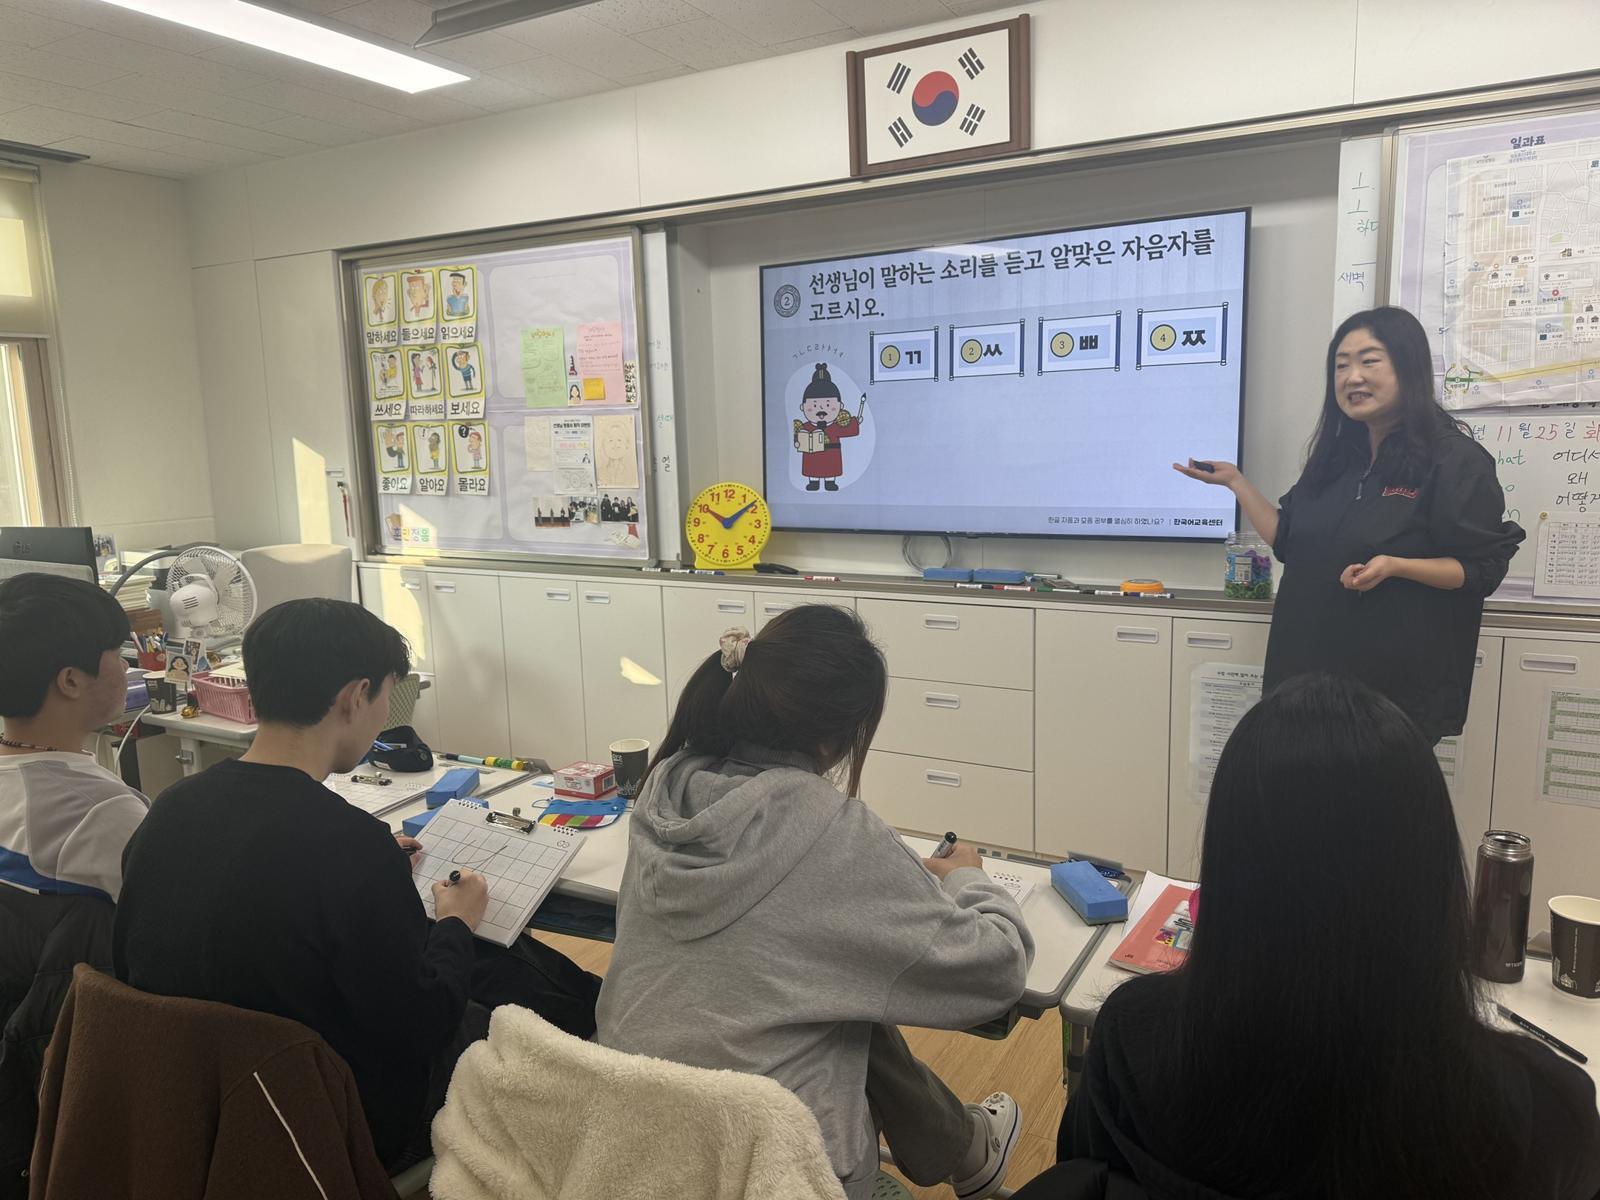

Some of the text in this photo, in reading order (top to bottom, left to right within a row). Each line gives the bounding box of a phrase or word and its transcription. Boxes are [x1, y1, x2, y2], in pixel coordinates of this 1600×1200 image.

[1510, 136, 1546, 149] 일과표
[808, 228, 1216, 296] 선생님이 말하는 소리를 듣고 알맞은 자음자를
[783, 296, 792, 307] 2
[808, 297, 885, 322] 고르시오.
[366, 330, 397, 345] 말하세요
[401, 327, 435, 342] 들으세요
[440, 325, 475, 341] 읽으세요
[1159, 329, 1207, 347] 4 ㅉ
[1059, 334, 1099, 351] 3 ㅃ
[887, 350, 923, 365] 1 ㄲ
[968, 343, 1004, 358] 2 ㅆ
[374, 402, 402, 417] 쓰세요
[410, 403, 444, 415] 따라하세요
[450, 400, 481, 416] 보세요
[382, 476, 408, 492] 좋아요
[418, 477, 445, 493] 알아요
[457, 476, 486, 493] 몰라요
[1567, 471, 1589, 486] 왜
[711, 492, 721, 503] 11
[724, 489, 735, 500] 12
[741, 494, 747, 504] 1
[750, 504, 758, 514] 2
[693, 518, 700, 528] 9
[754, 519, 761, 529] 3
[1094, 517, 1113, 525] 공부를
[1114, 517, 1134, 525] 열심히
[1173, 517, 1224, 527] 한국어교육센터
[392, 527, 430, 543] 훈민정음
[697, 533, 705, 544] 8
[748, 535, 756, 545] 4
[707, 544, 715, 555] 7
[722, 548, 729, 559] 6
[736, 545, 744, 556] 5
